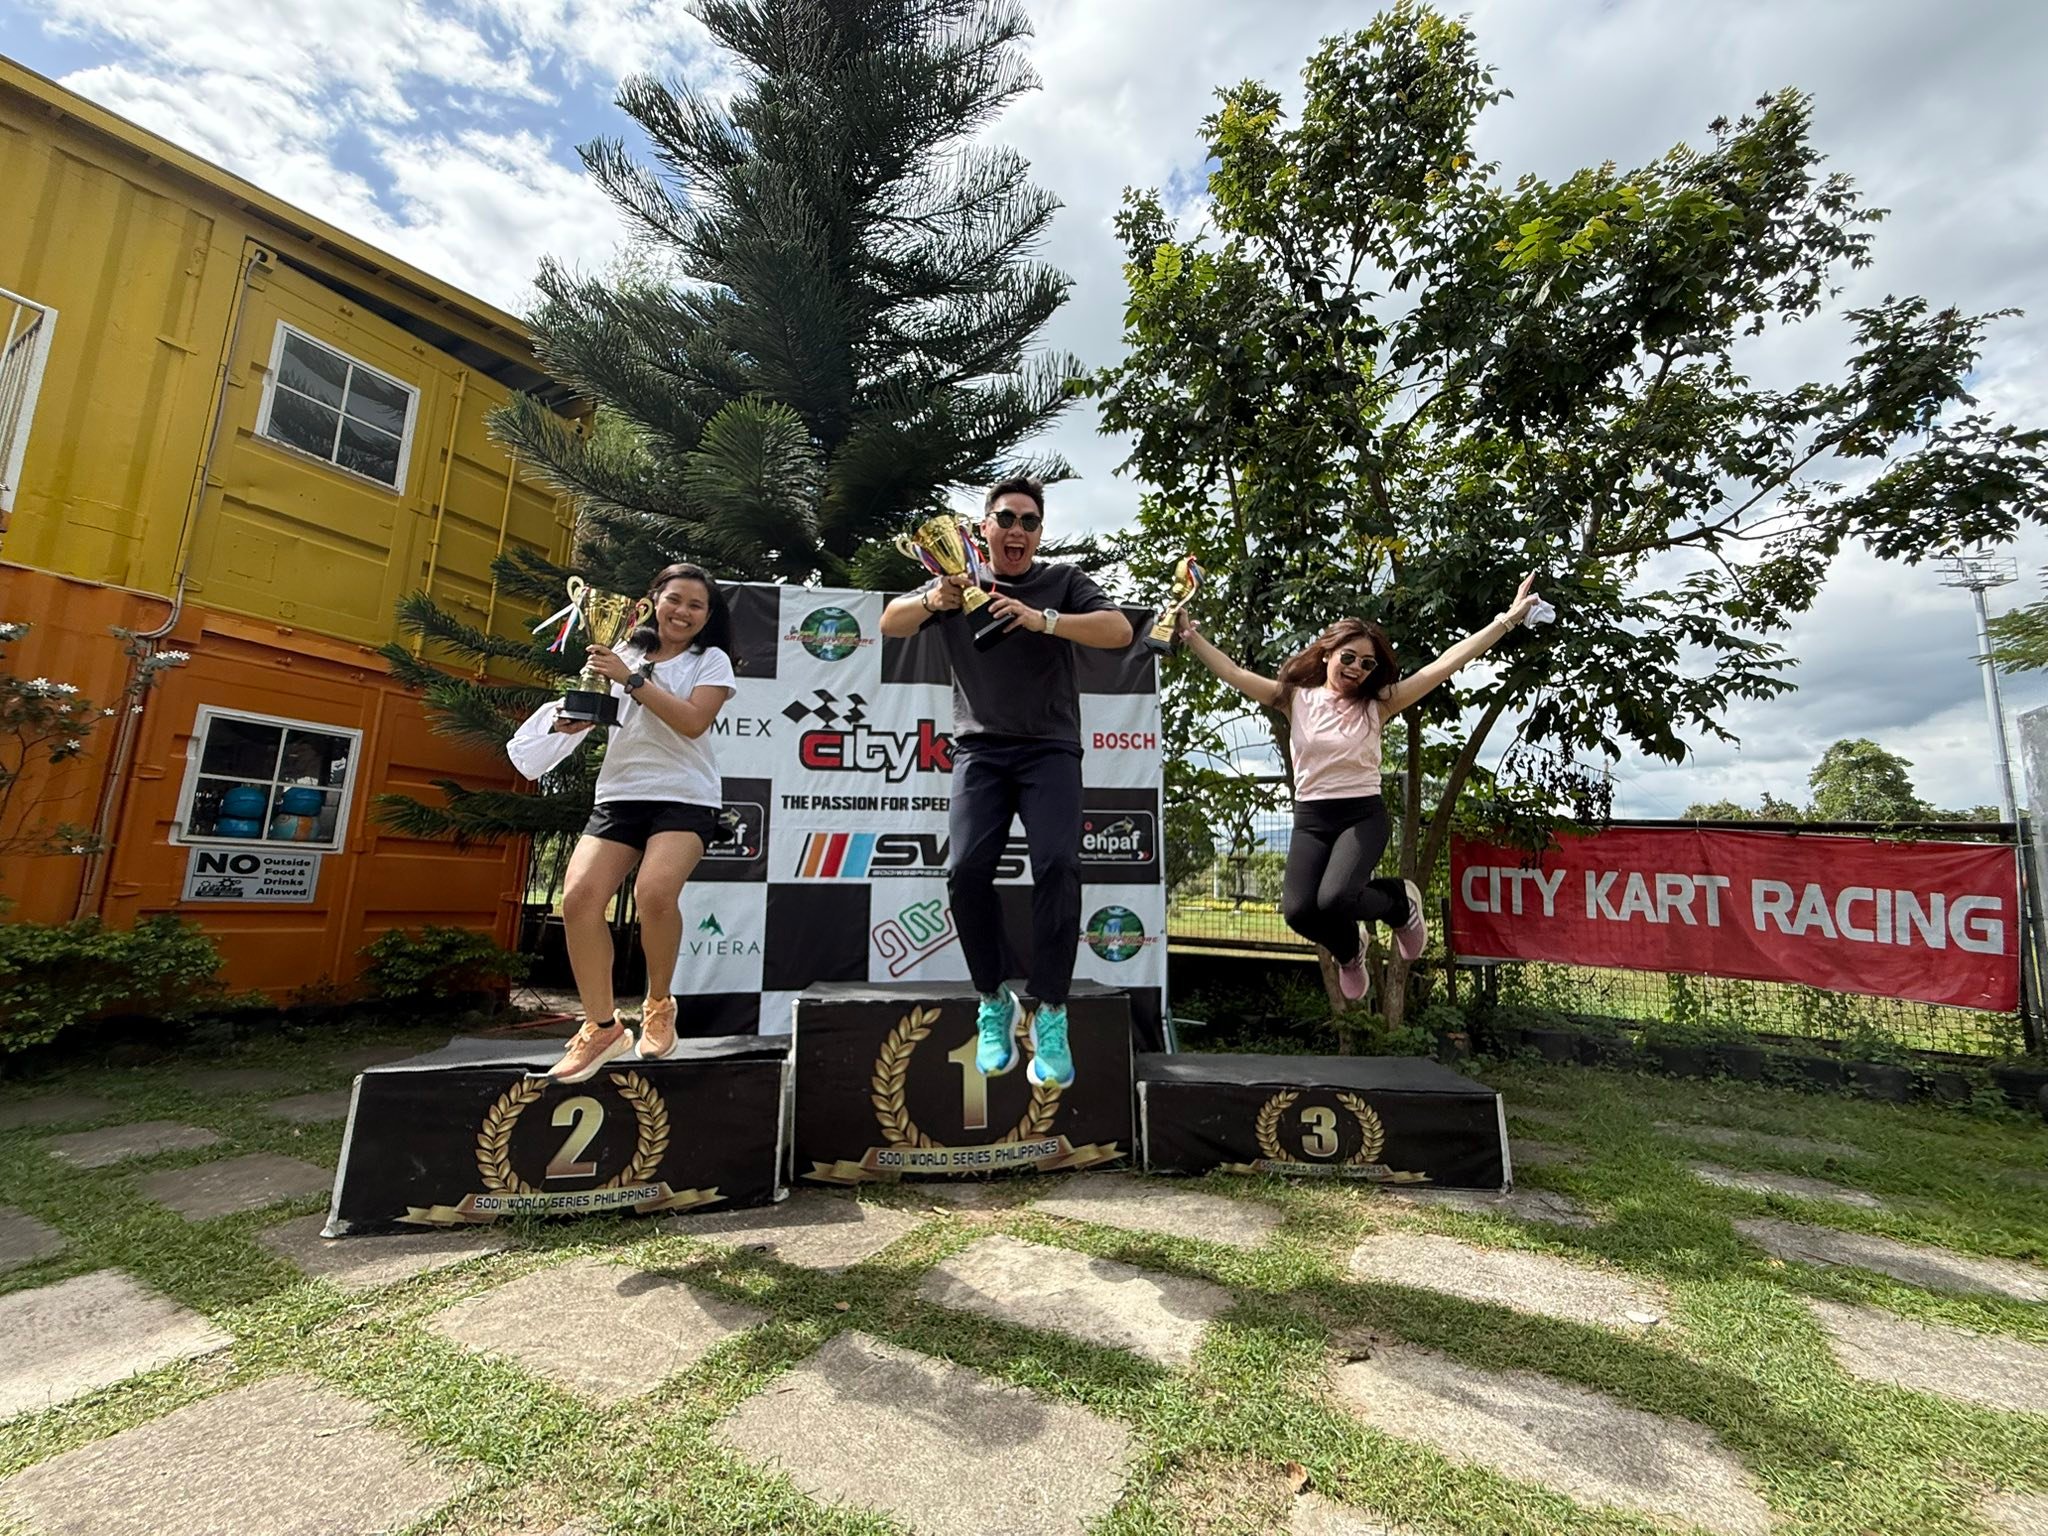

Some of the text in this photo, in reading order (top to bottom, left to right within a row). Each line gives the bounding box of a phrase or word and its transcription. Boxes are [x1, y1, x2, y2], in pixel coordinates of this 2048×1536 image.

[710, 717, 772, 737] MEX
[800, 719, 953, 784] cityk
[1092, 732, 1156, 750] BOSCH
[781, 795, 809, 810] THE
[811, 795, 878, 811] PASSION
[880, 797, 909, 812] FOR
[197, 852, 261, 874] NO
[263, 858, 311, 867] Outside
[265, 868, 306, 876] Food &
[255, 887, 307, 896] Allowed
[263, 878, 304, 886] Drinks
[1461, 865, 2004, 955] CITY KART RACING
[679, 940, 761, 955] VIERA
[948, 1034, 988, 1130] 1
[545, 1096, 604, 1180] 2
[1301, 1106, 1338, 1157] 3
[877, 1140, 1058, 1166] SODI WORLD SERIES PHILIPPINES
[474, 1186, 658, 1210] SODI WORLD SERIES PHILIPPINES
